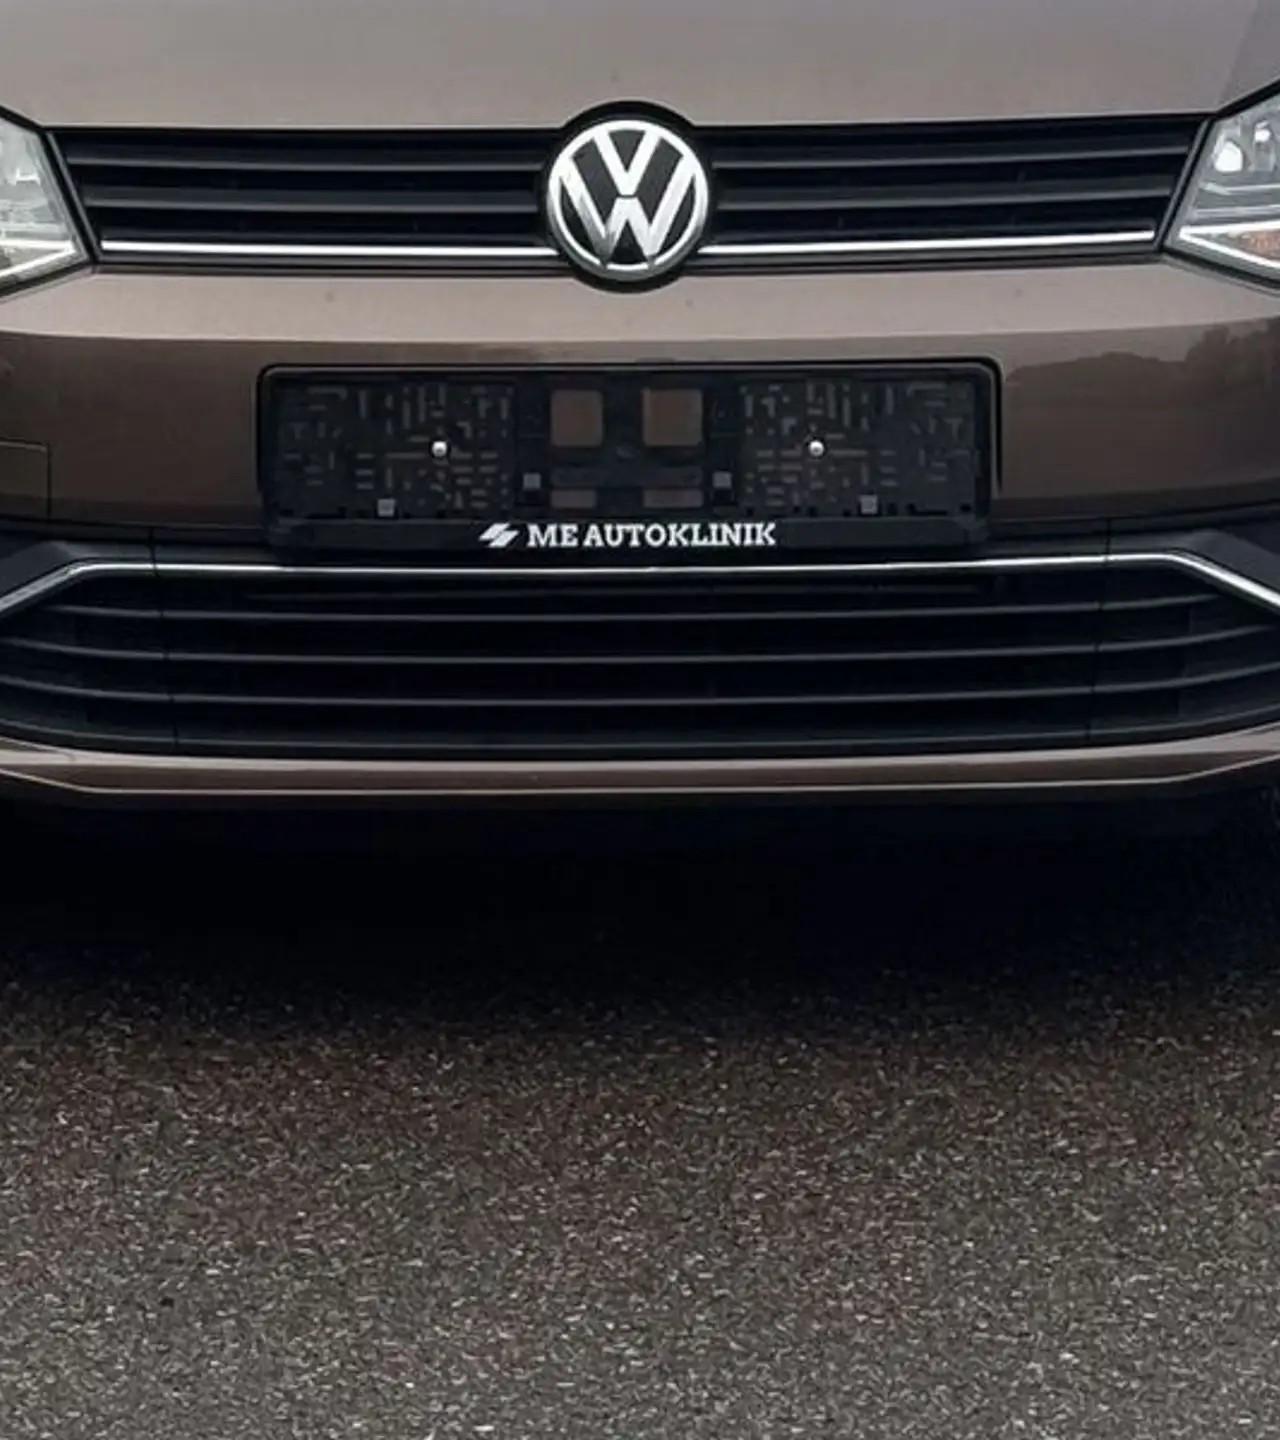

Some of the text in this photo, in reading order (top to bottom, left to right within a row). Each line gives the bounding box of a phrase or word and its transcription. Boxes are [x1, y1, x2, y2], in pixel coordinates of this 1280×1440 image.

[556, 123, 700, 262] VW
[527, 521, 776, 547] ME AUTOKLINIK
